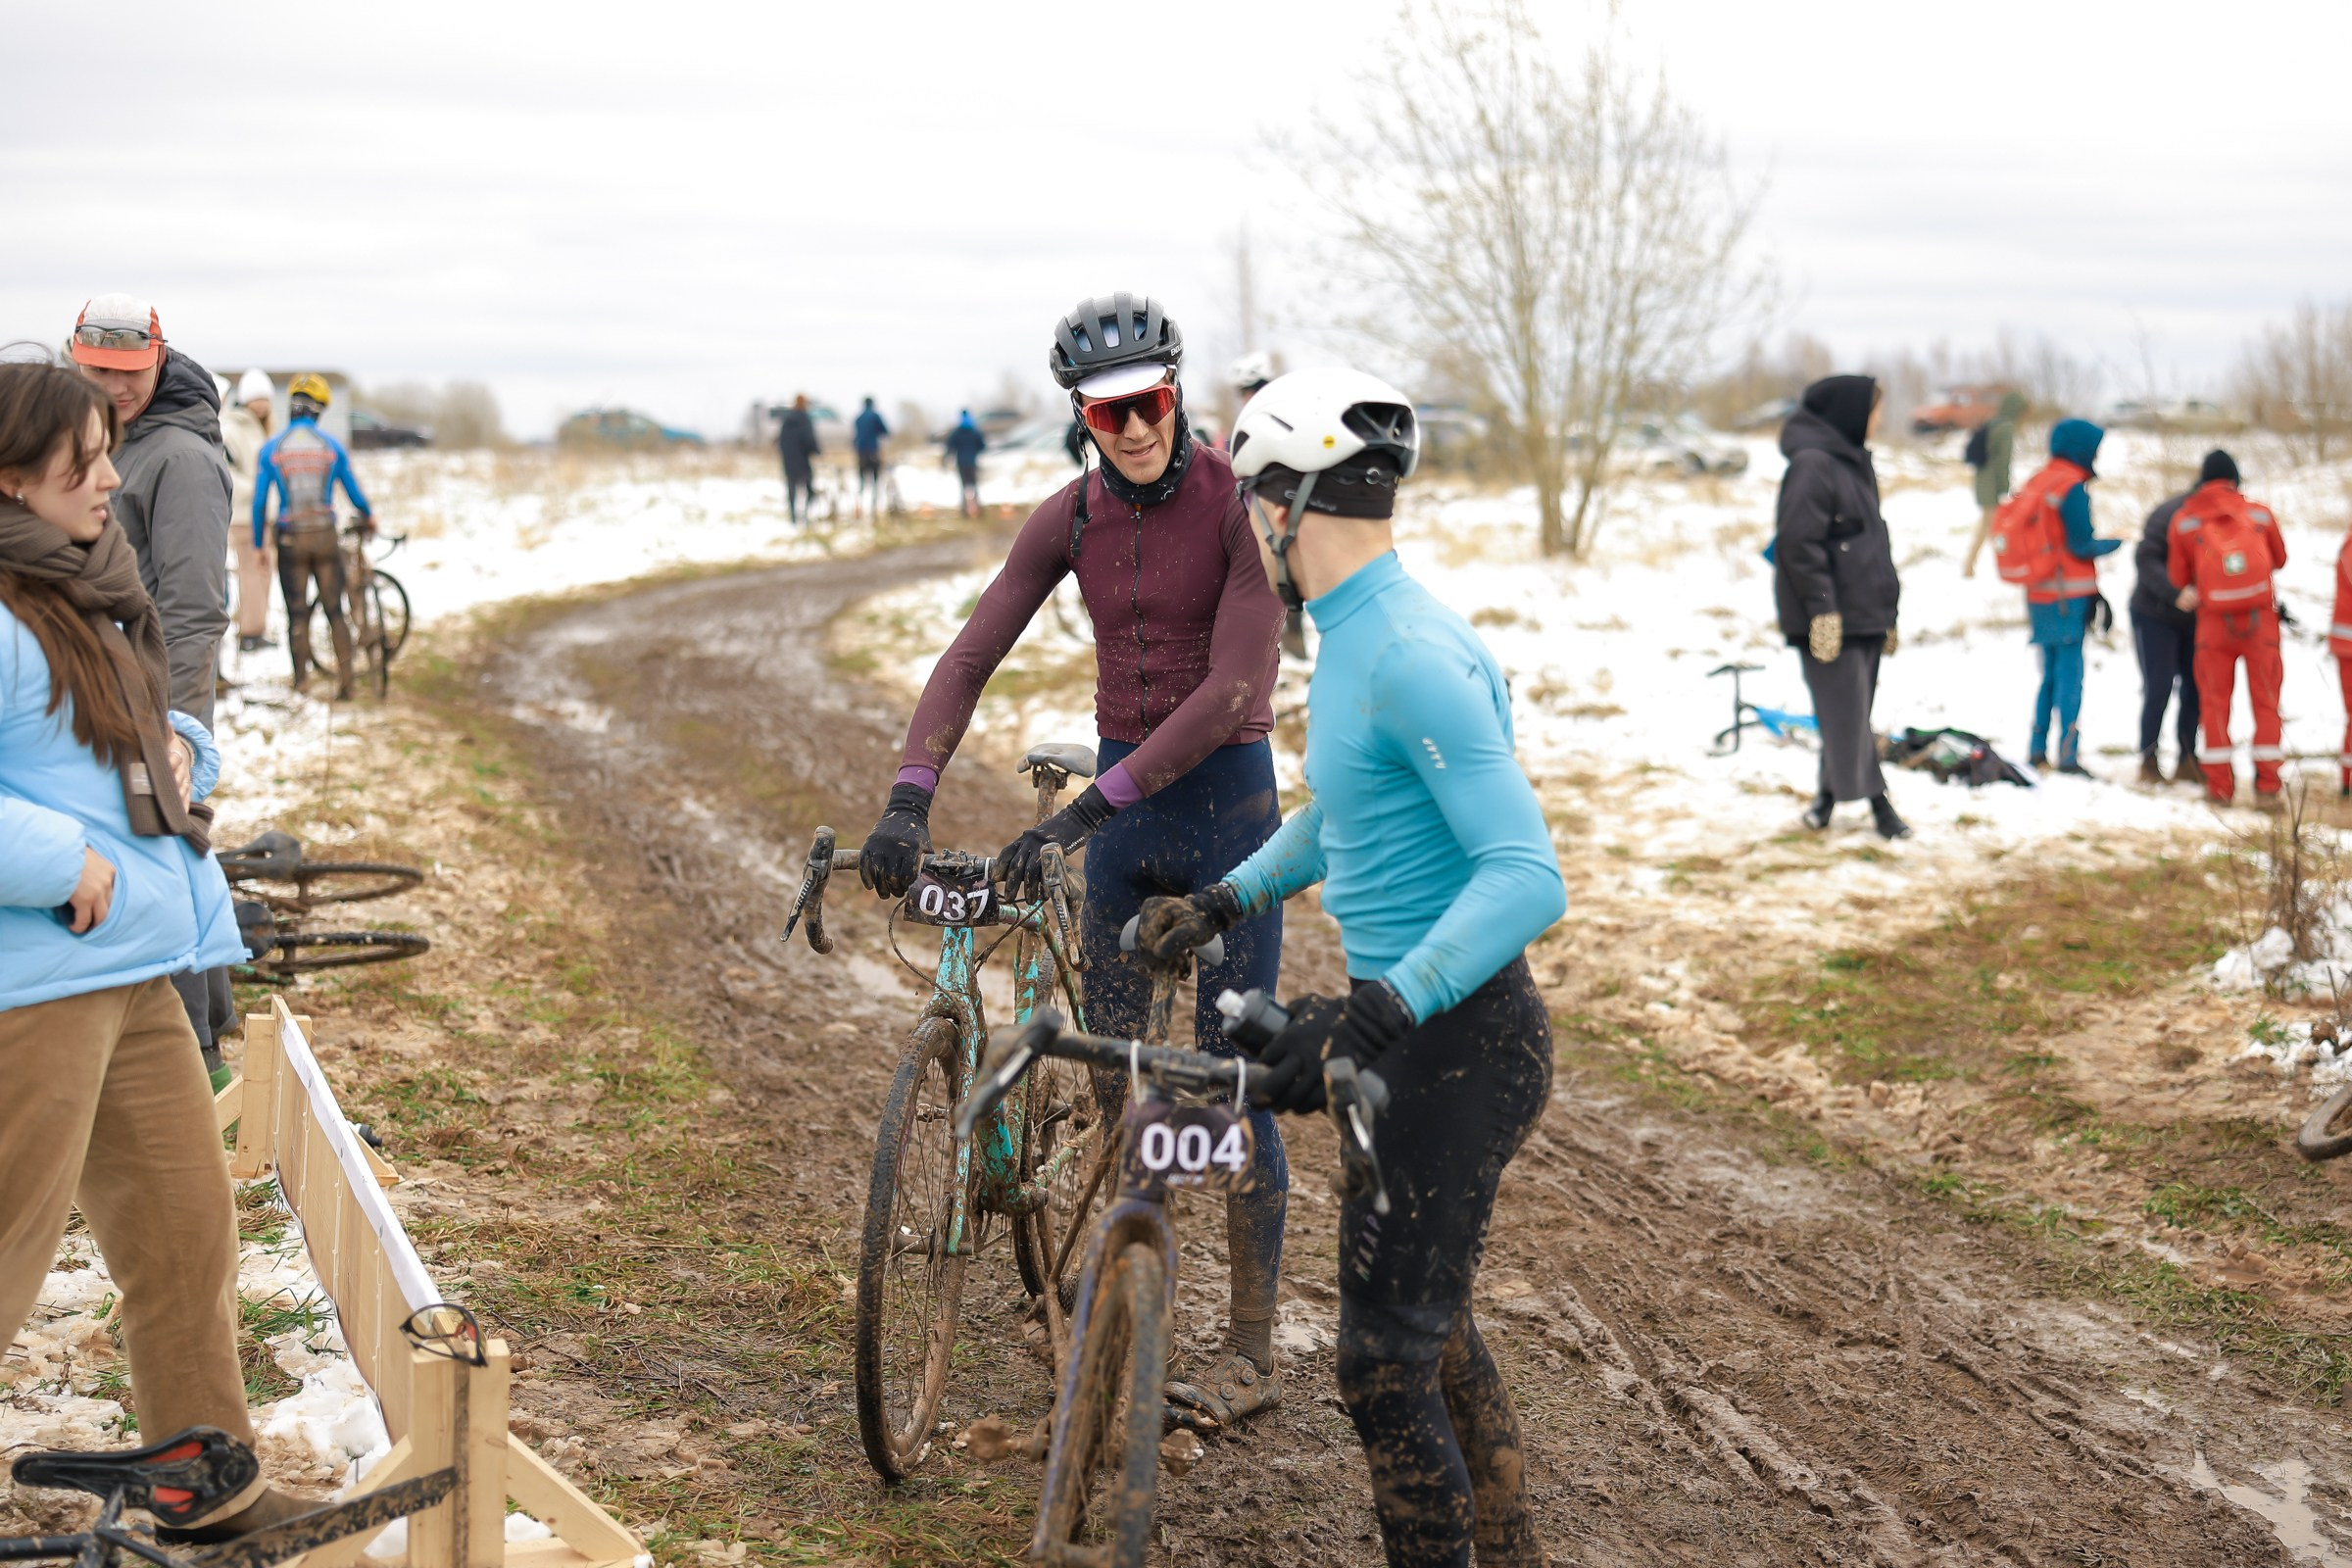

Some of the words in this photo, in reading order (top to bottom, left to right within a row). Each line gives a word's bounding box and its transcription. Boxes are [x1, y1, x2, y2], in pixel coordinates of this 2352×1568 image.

[919, 884, 990, 921] 037
[1140, 1121, 1247, 1172] 004
[1352, 1214, 1382, 1282] MAAP
